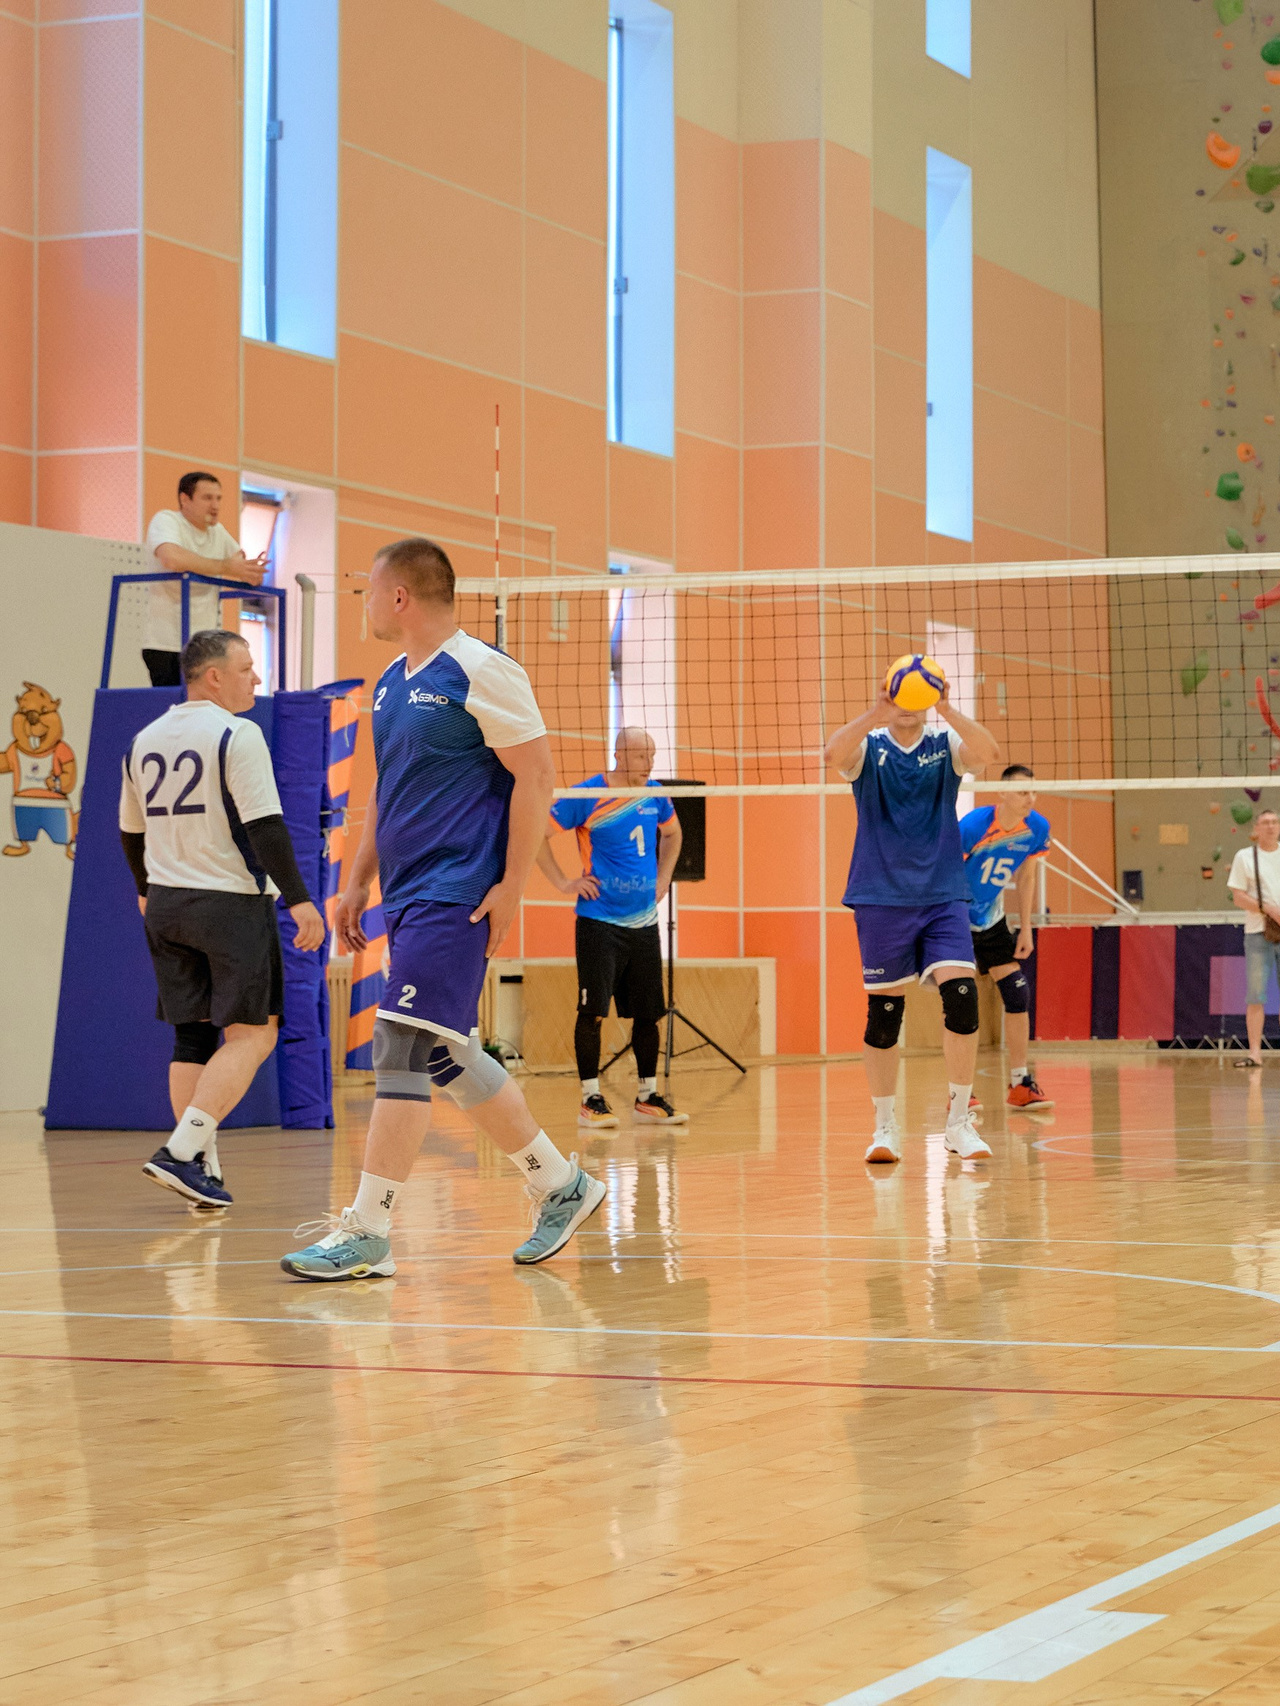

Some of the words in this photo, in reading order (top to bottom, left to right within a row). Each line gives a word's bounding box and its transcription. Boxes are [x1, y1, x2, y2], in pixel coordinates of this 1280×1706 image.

[373, 686, 388, 711] 2
[877, 747, 888, 766] 7
[141, 749, 206, 817] 22
[629, 824, 646, 857] 1
[980, 856, 1015, 887] 15
[397, 984, 417, 1009] 2
